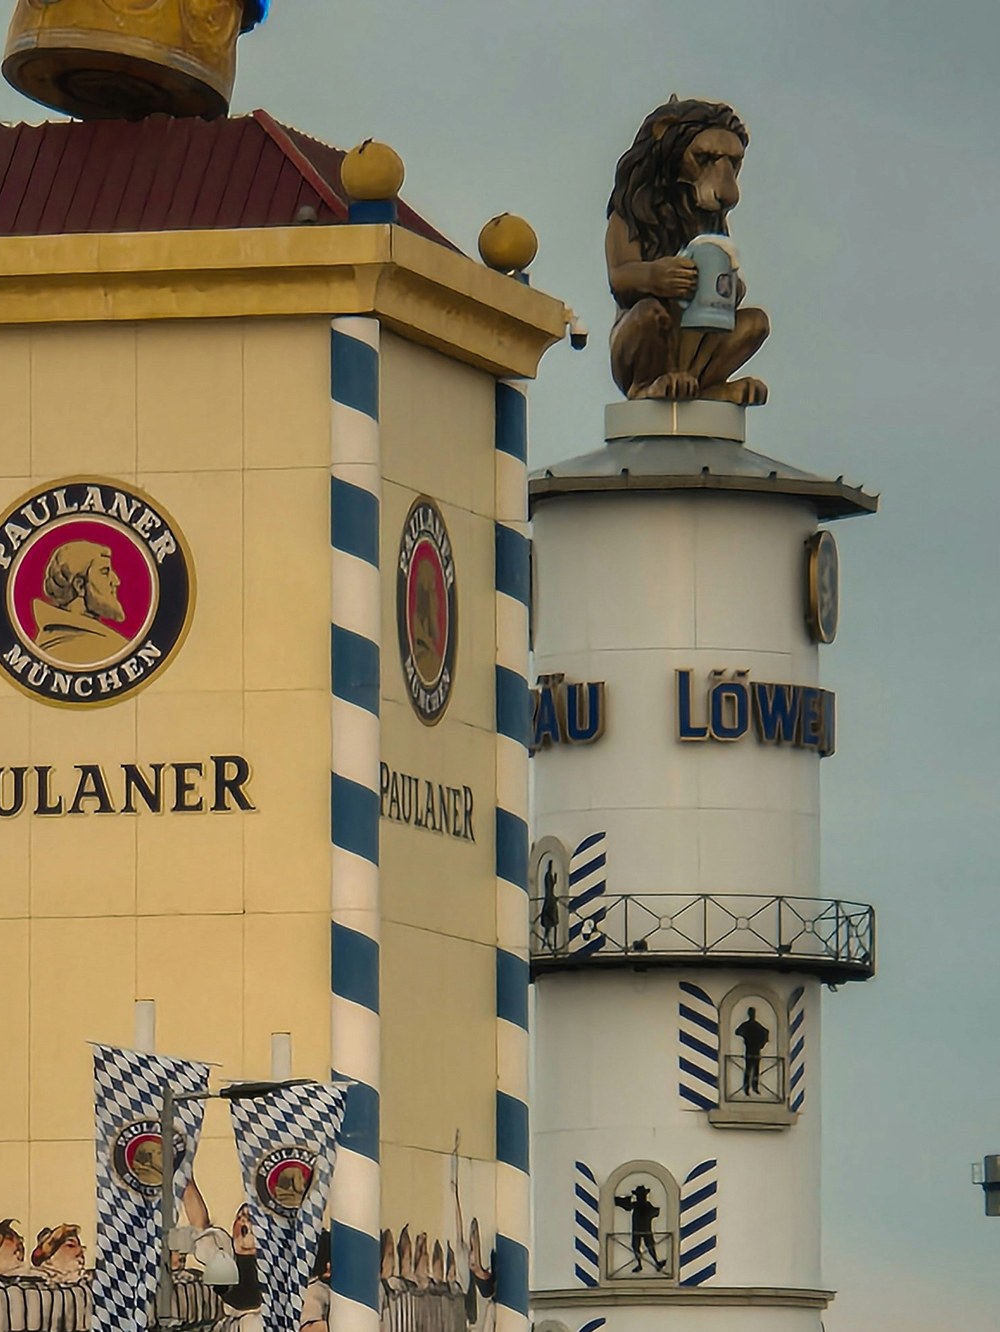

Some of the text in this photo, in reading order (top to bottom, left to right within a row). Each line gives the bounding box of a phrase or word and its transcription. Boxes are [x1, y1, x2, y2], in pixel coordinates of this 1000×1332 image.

[3, 640, 162, 697] MÜNCHEN
[531, 673, 605, 751] ÄU
[379, 761, 476, 844] PAULANER
